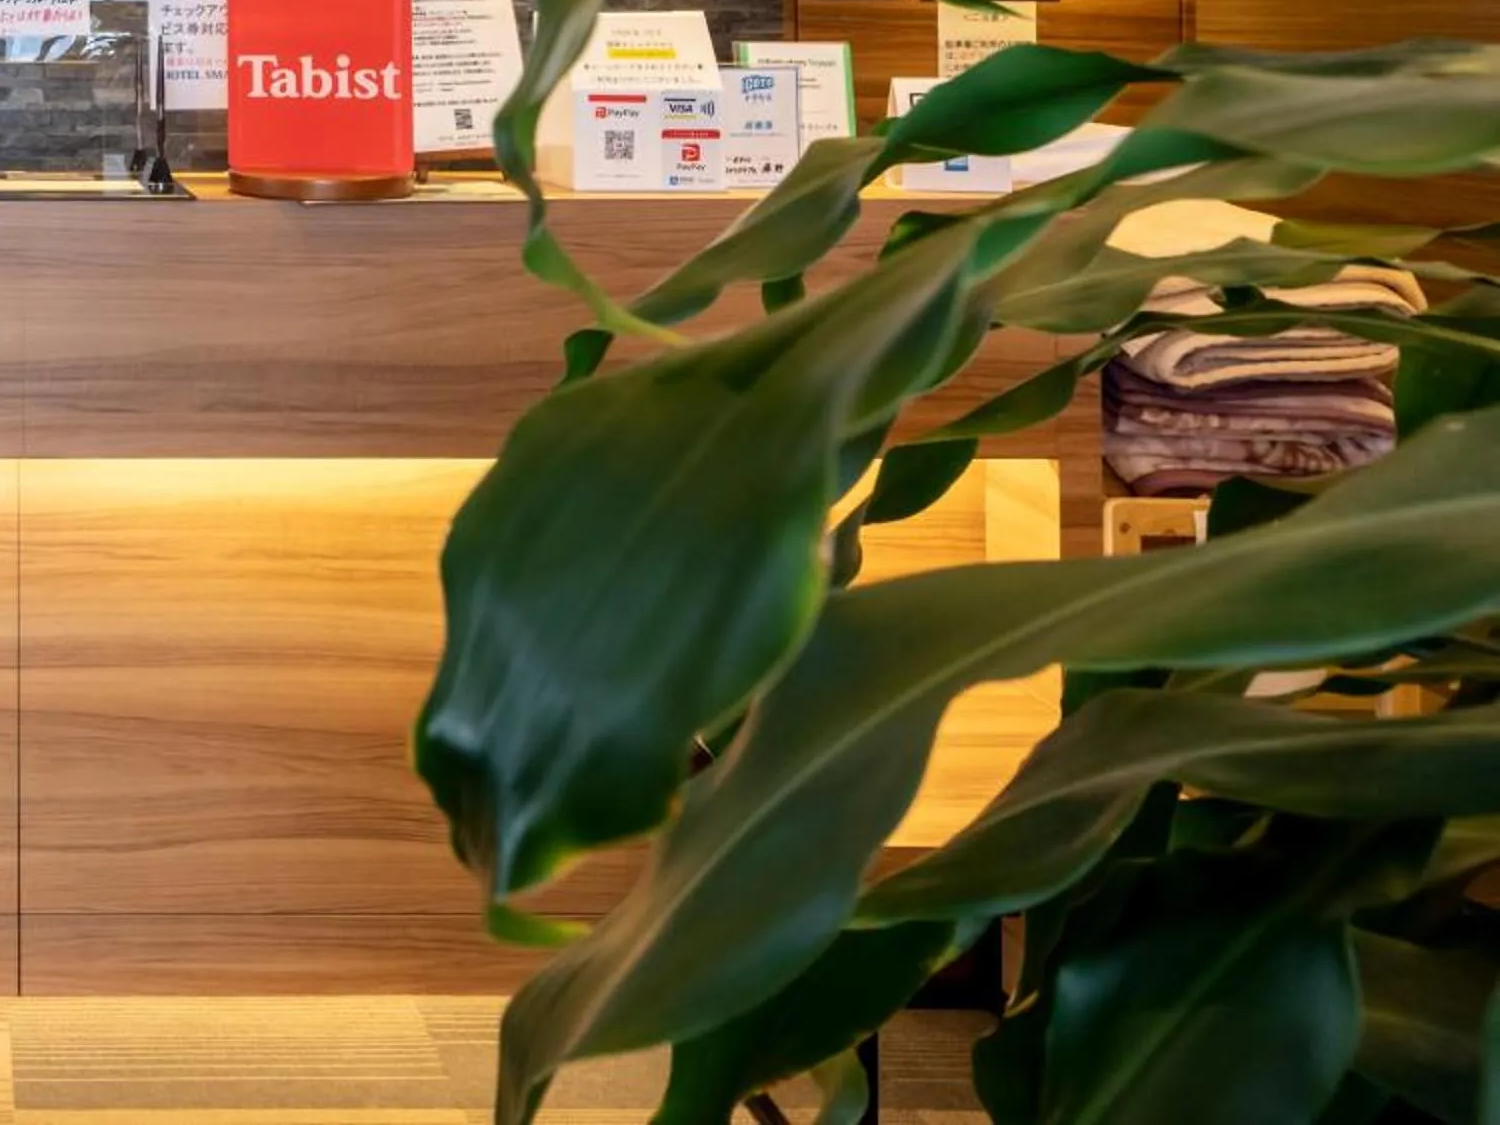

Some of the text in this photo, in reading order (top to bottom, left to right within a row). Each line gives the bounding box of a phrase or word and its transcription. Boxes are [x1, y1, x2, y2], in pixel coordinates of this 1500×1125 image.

[237, 54, 402, 100] Tabist
[608, 107, 640, 119] PayPay
[669, 103, 694, 114] VISA
